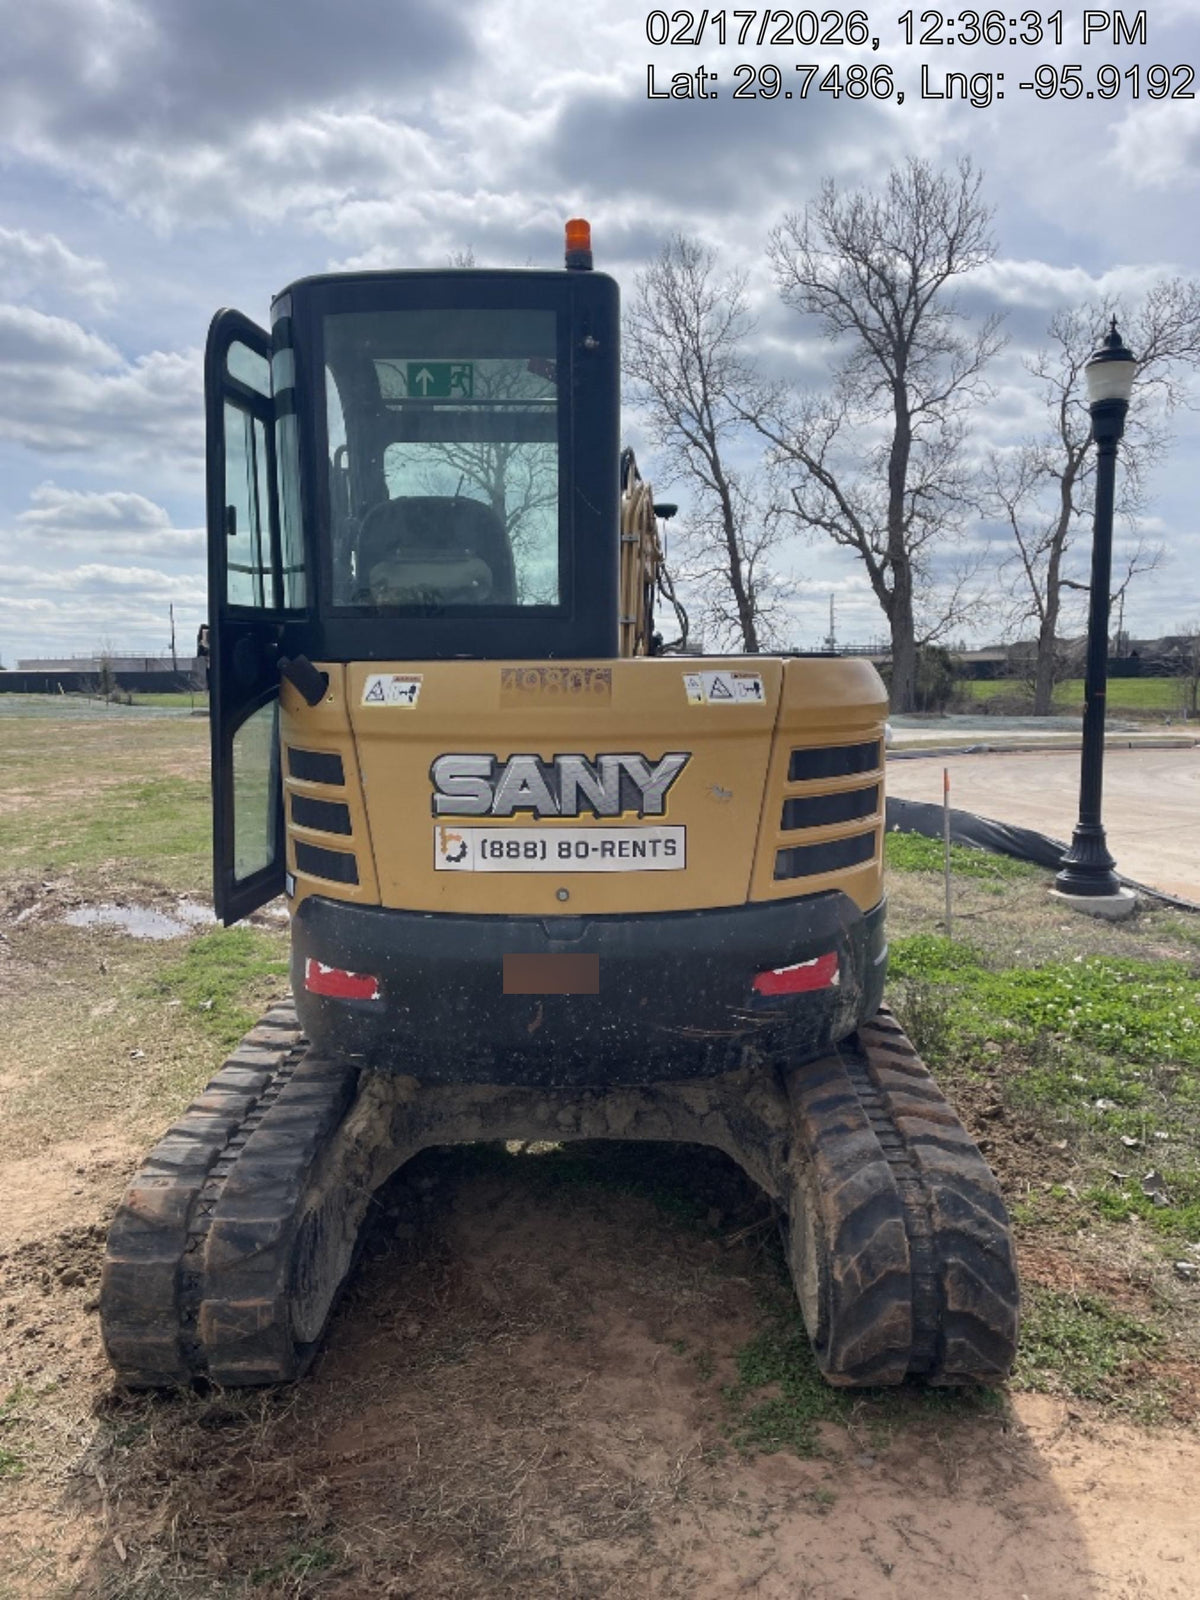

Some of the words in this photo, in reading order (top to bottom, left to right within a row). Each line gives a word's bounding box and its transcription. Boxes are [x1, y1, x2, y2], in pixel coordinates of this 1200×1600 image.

[430, 753, 692, 818] SANY
[481, 838, 547, 860] (888)
[557, 838, 677, 860] 80-RENTS
